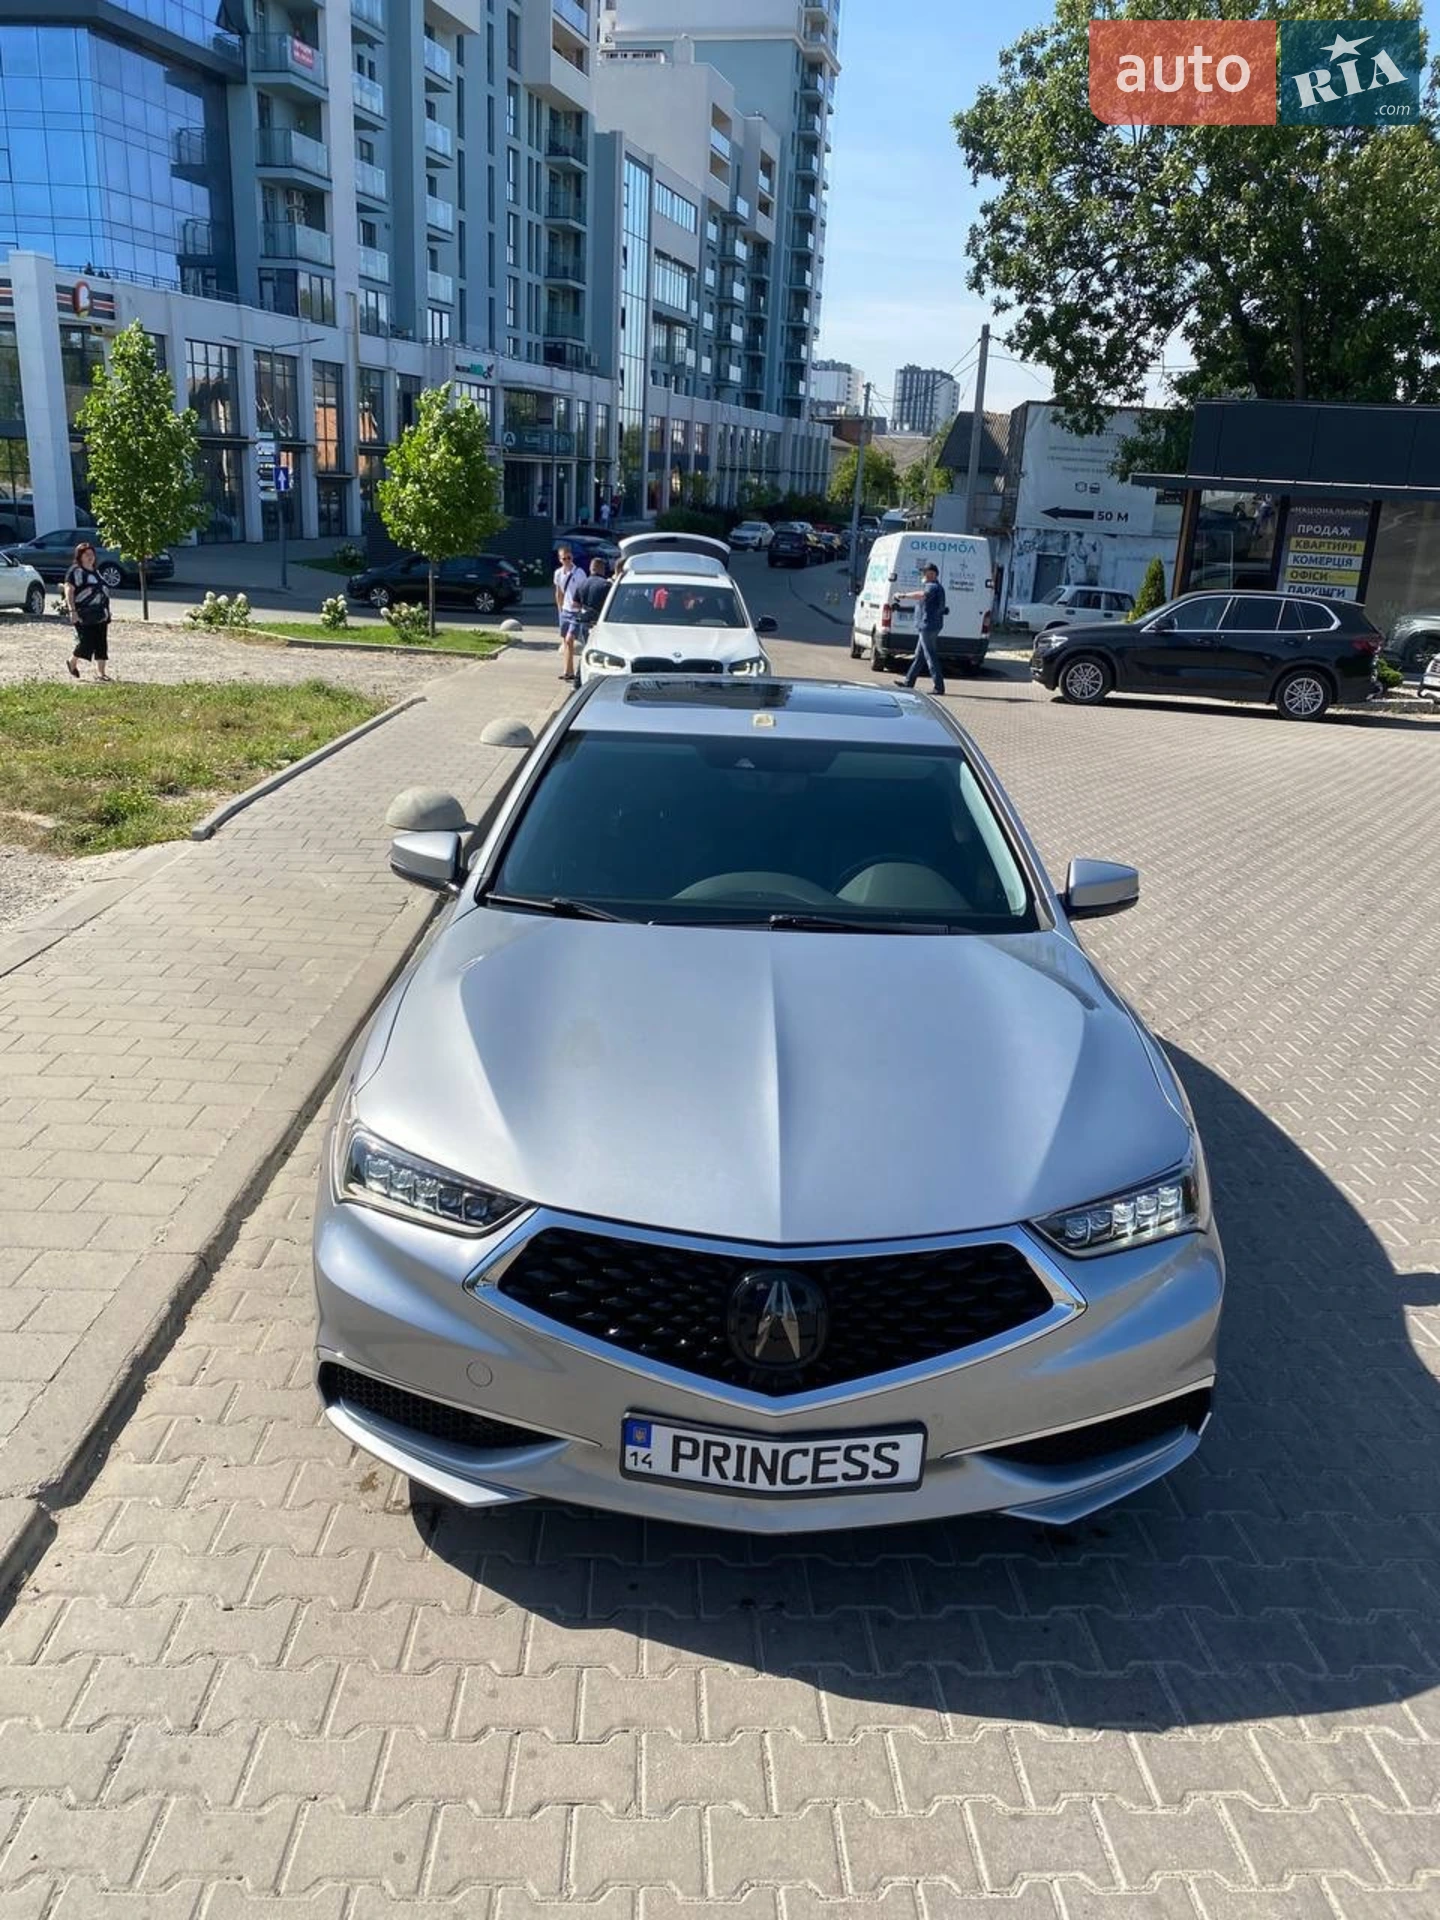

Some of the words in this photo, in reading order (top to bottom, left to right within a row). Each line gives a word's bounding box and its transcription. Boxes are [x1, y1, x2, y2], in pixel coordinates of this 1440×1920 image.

[1097, 511, 1113, 521] 50
[1297, 524, 1351, 536] ПРОДАЖ
[1295, 540, 1357, 552] КВАРТИРИ
[1292, 555, 1353, 567] КОМЕРЦІЯ
[1290, 570, 1329, 580] ОФІСИ
[629, 1451, 652, 1469] 14
[671, 1434, 901, 1486] PRINCESS
